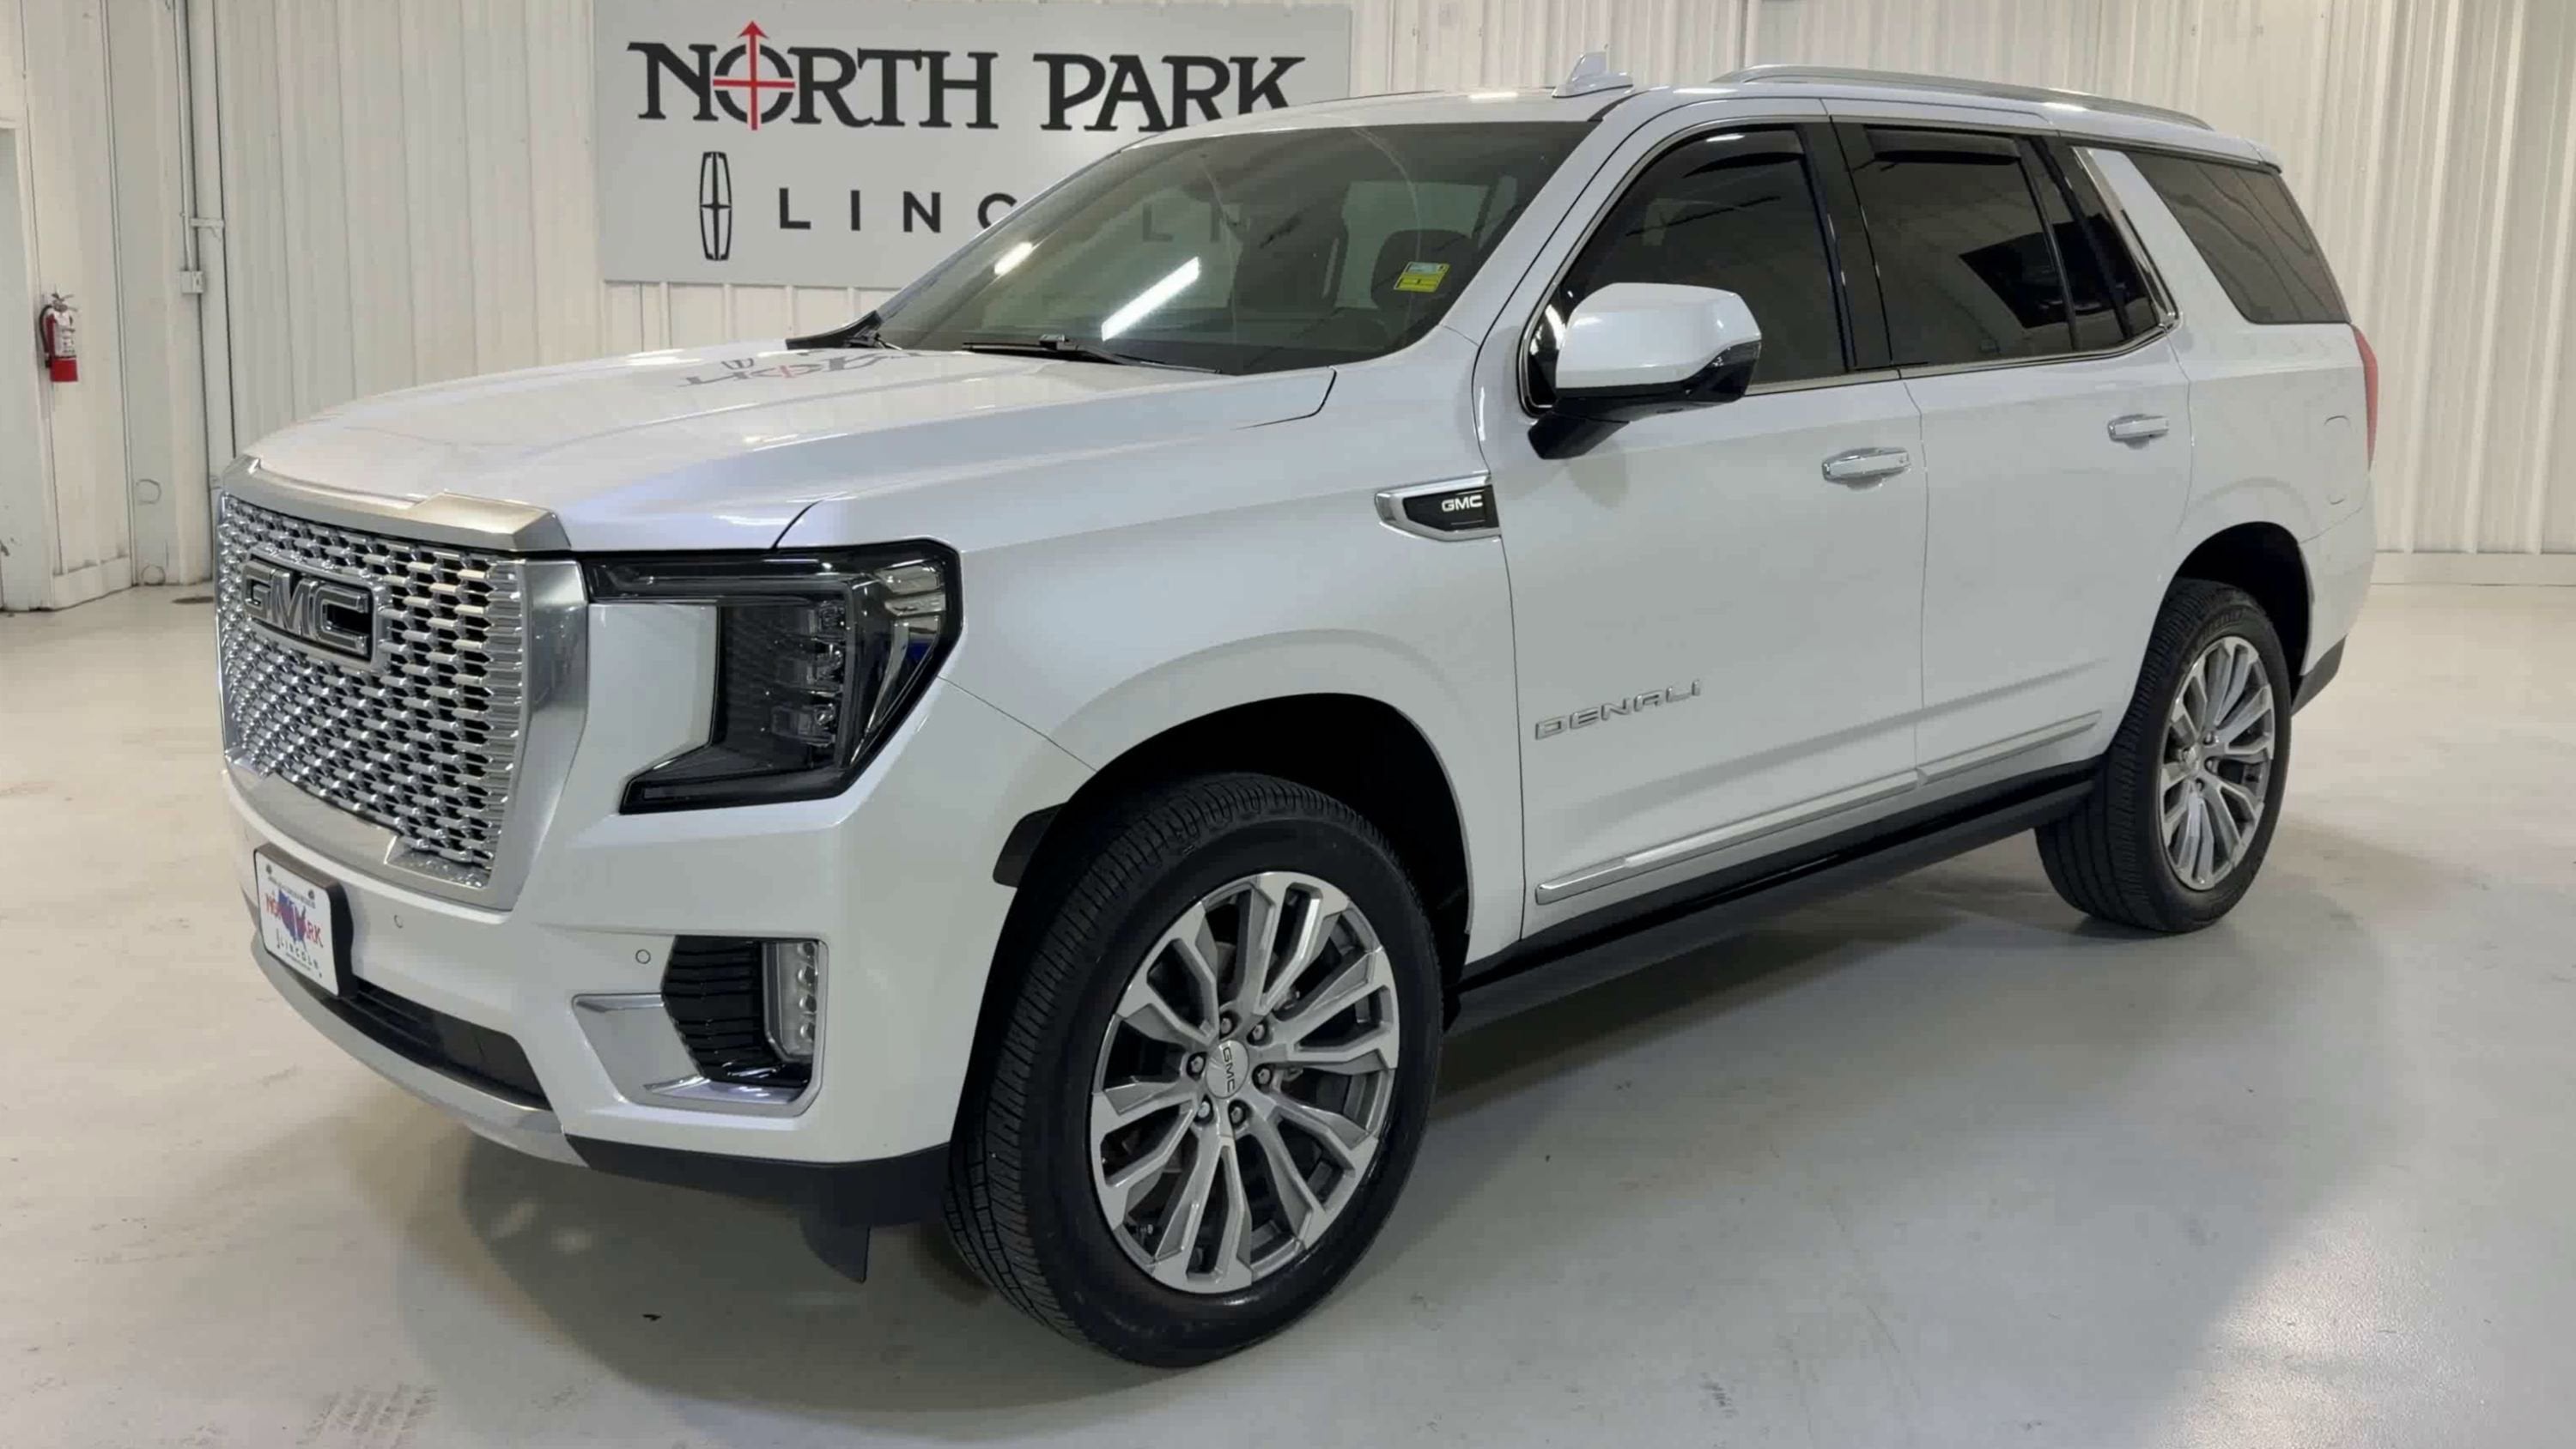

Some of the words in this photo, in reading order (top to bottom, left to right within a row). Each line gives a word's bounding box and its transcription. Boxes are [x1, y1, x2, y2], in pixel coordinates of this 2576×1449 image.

[627, 41, 999, 130] NORTH
[1033, 53, 1306, 132] PARK
[1441, 494, 1484, 512] GMC
[241, 560, 370, 655] GMC
[1534, 679, 1701, 740] DENALI
[1223, 1046, 1235, 1093] GMC
